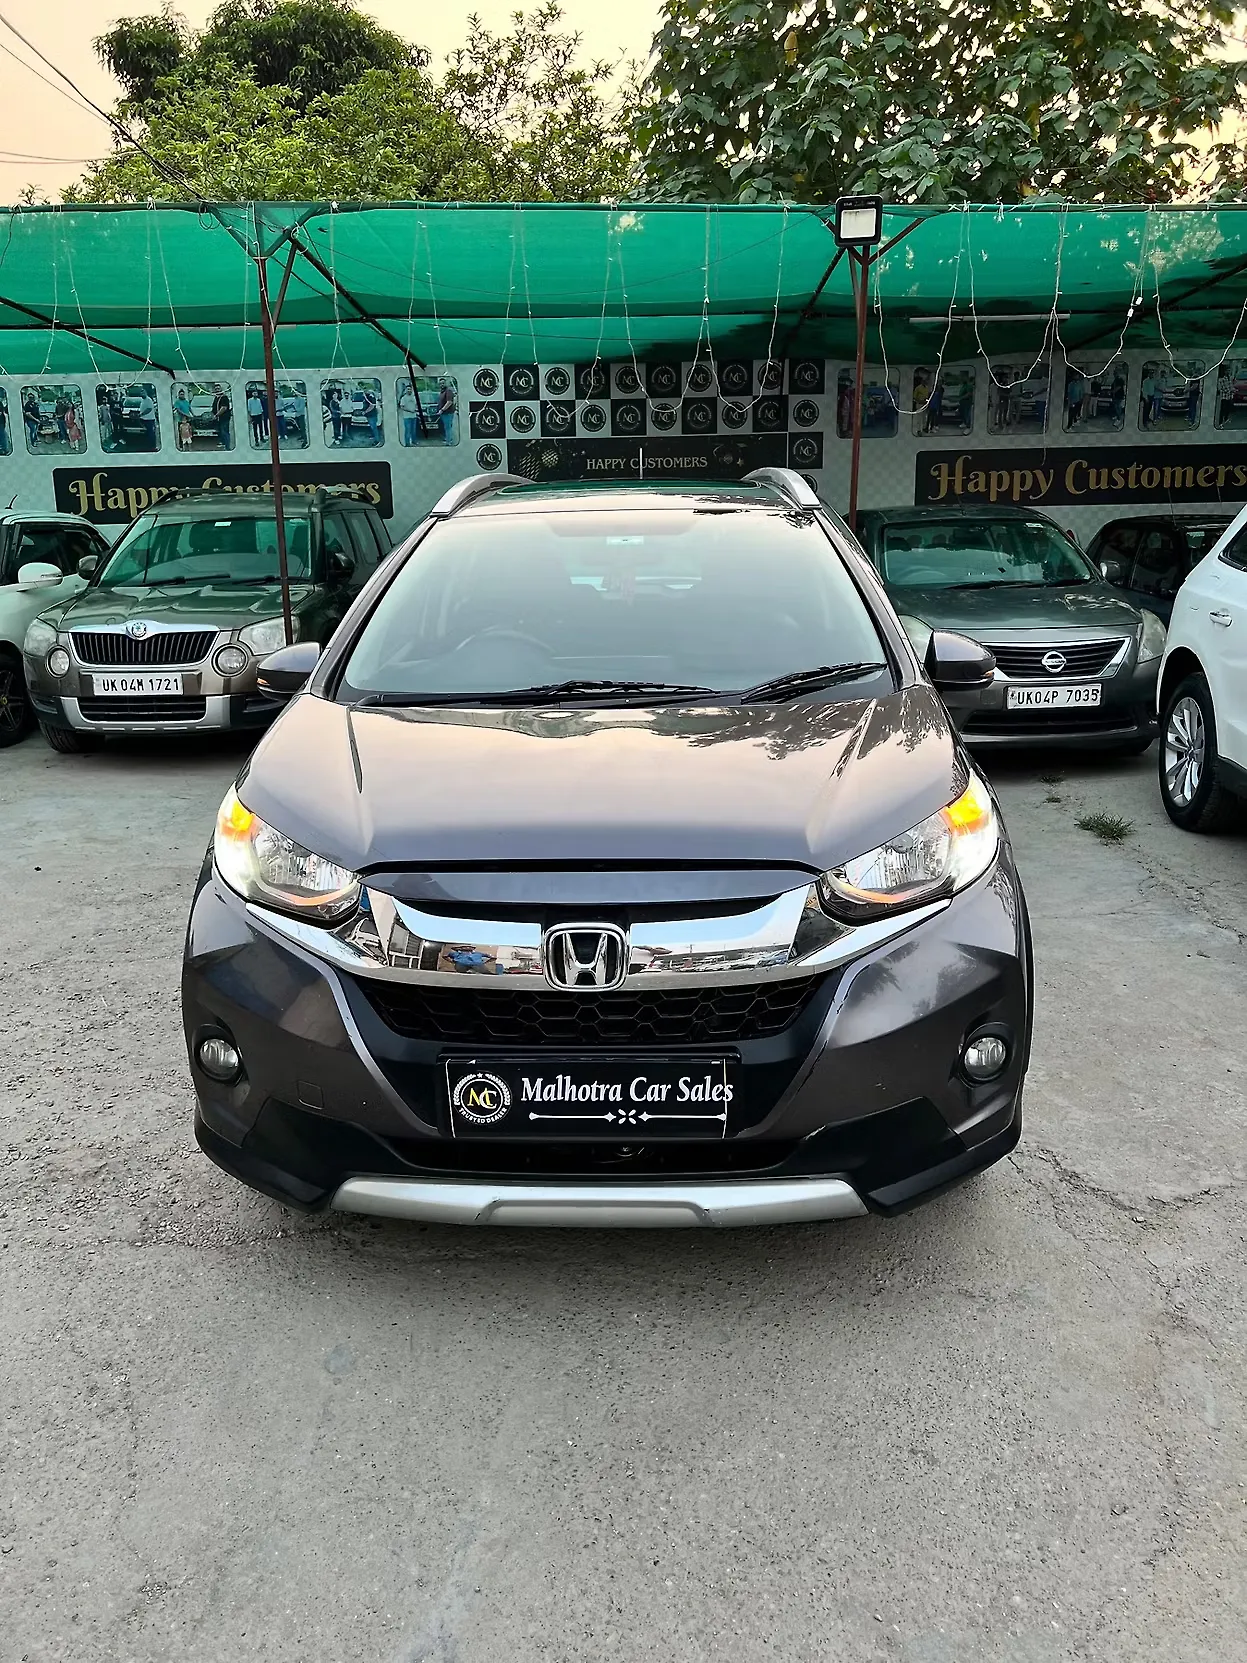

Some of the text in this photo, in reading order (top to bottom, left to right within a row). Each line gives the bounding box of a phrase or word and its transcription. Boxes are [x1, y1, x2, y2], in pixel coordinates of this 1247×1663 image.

[587, 456, 708, 470] HAPPY CUSTOMERS
[928, 455, 1247, 501] Happy Customers
[68, 472, 190, 519] Hap
[102, 678, 118, 692] UK
[148, 677, 179, 691] 1721
[1017, 688, 1100, 705] UK04P 7035
[521, 1074, 734, 1102] Malhotra Car Sales
